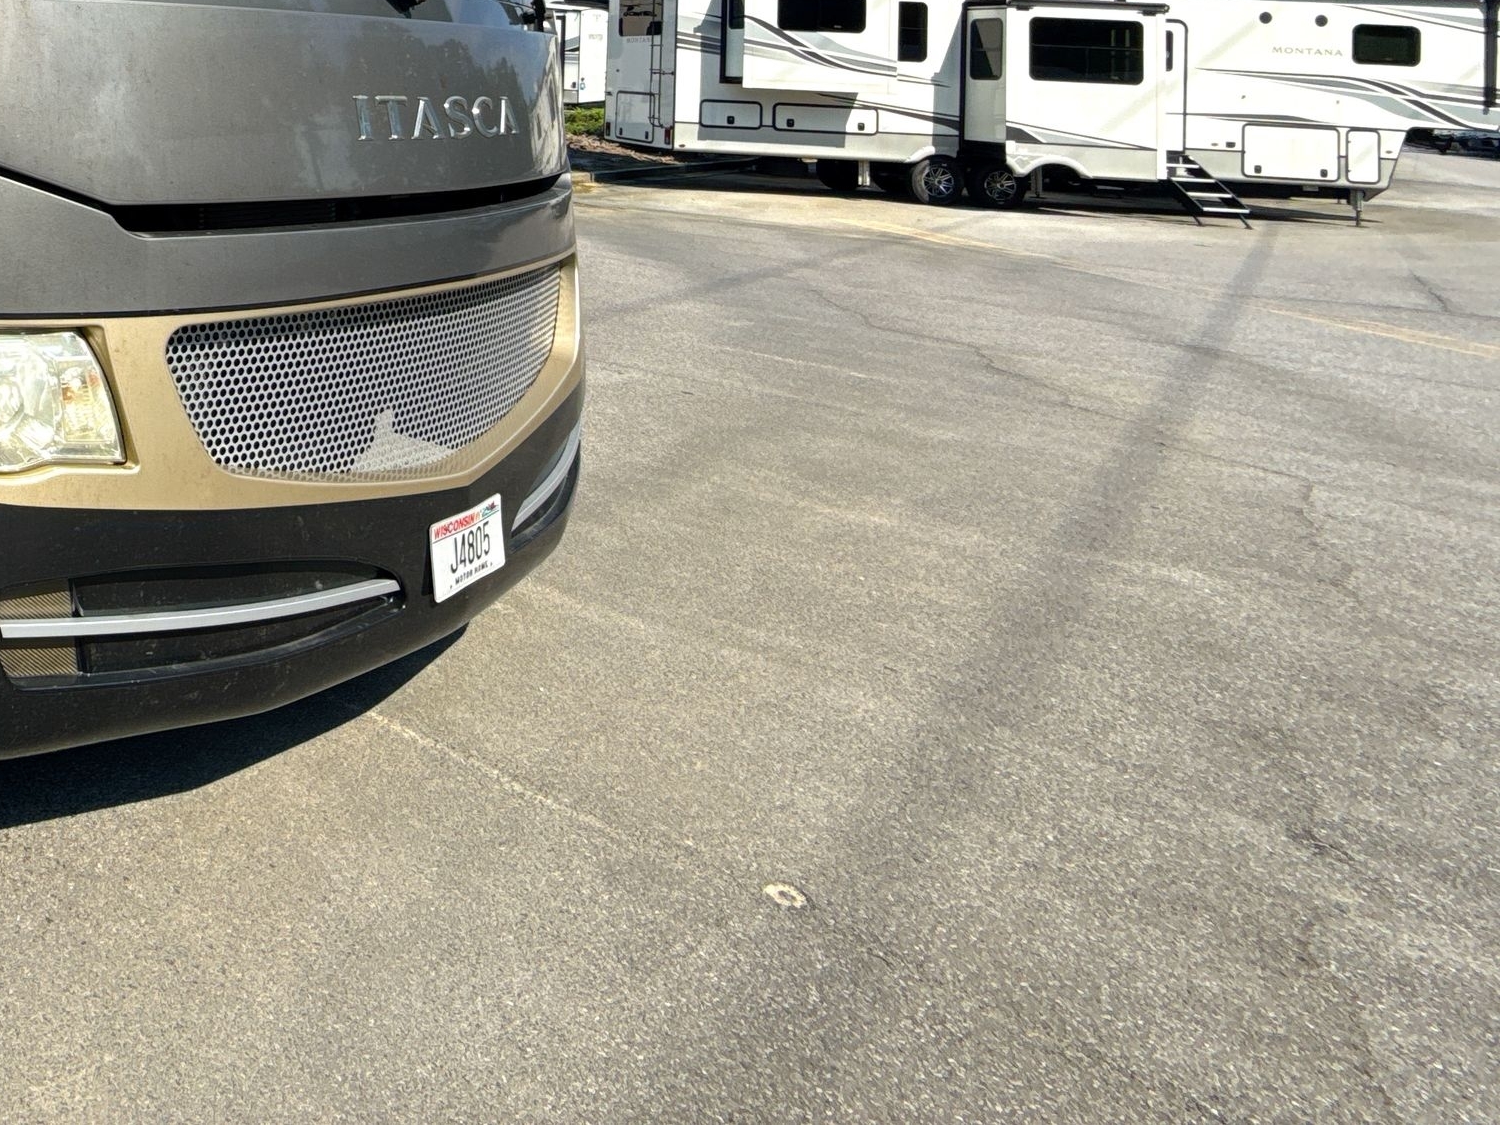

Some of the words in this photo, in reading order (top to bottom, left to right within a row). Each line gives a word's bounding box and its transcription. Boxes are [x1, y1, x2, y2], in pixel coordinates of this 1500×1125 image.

[1272, 46, 1343, 57] MONTANA
[352, 95, 520, 141] ITASCA
[433, 512, 476, 541] WISCONSIN
[450, 520, 491, 574] J4805
[455, 569, 473, 585] MOTOR
